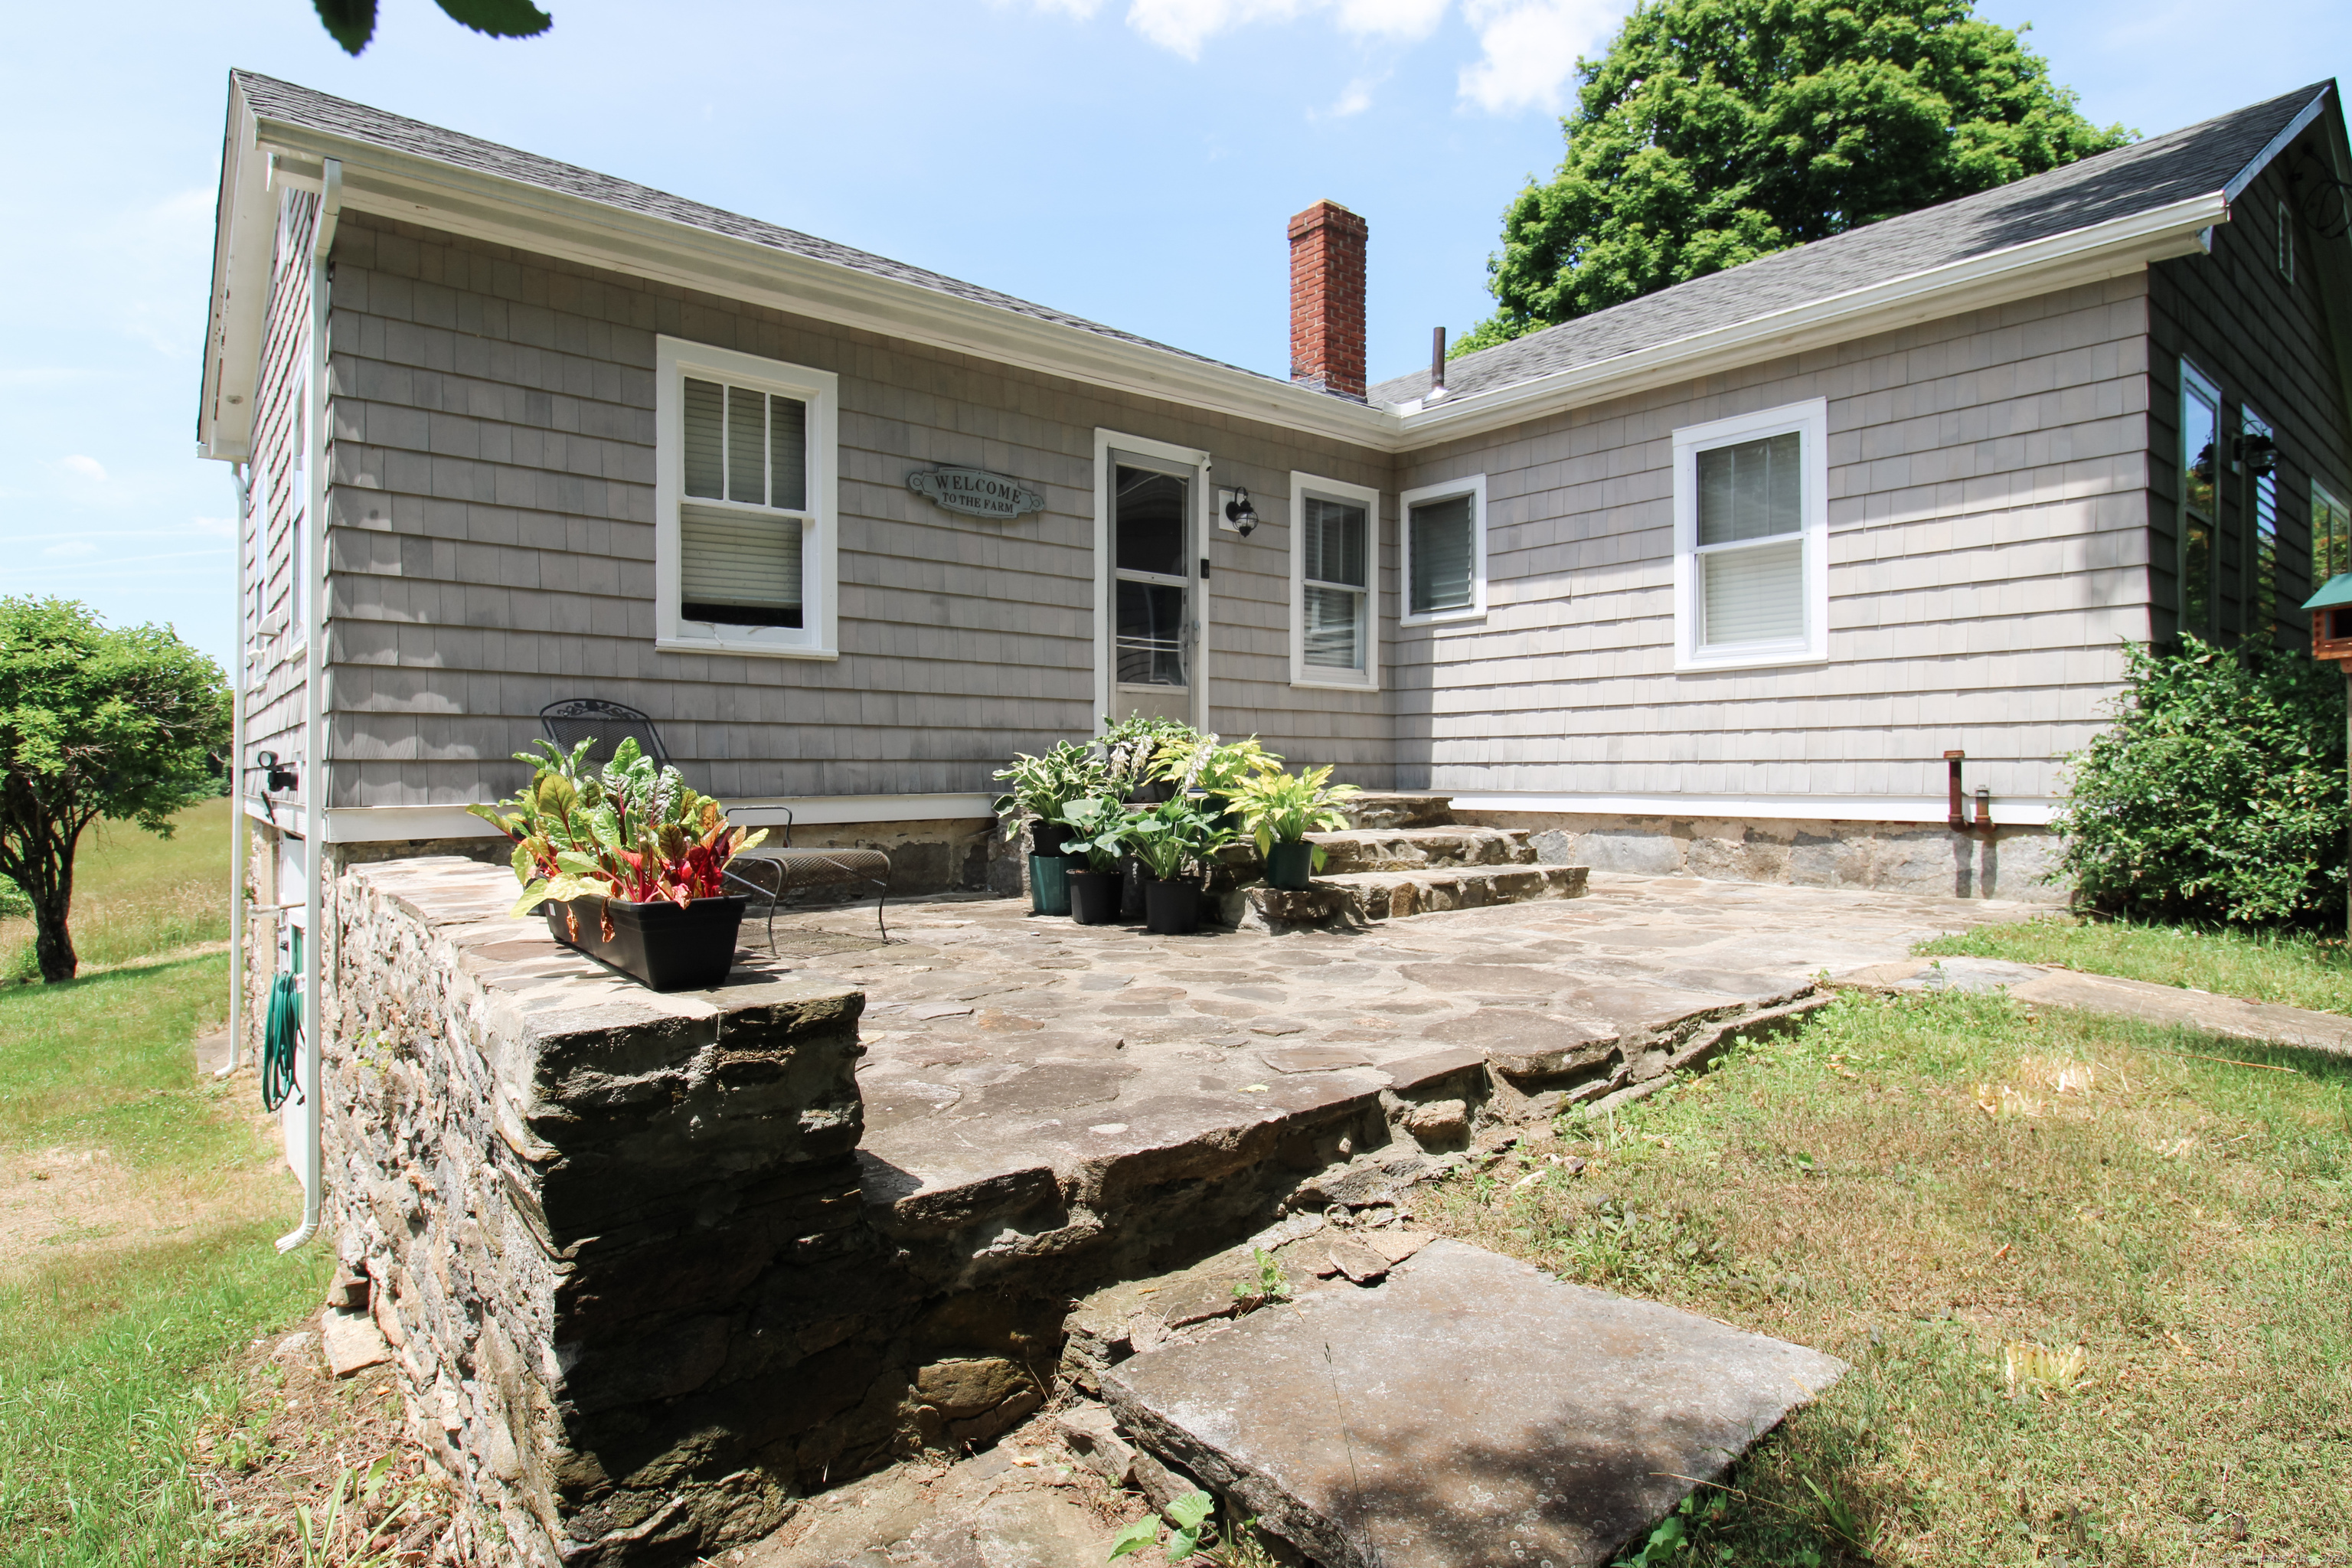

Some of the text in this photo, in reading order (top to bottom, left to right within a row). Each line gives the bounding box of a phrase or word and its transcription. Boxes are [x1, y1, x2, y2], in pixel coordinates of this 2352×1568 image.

[935, 475, 1021, 504] WELCOME
[942, 492, 1013, 513] TO THE FARM
